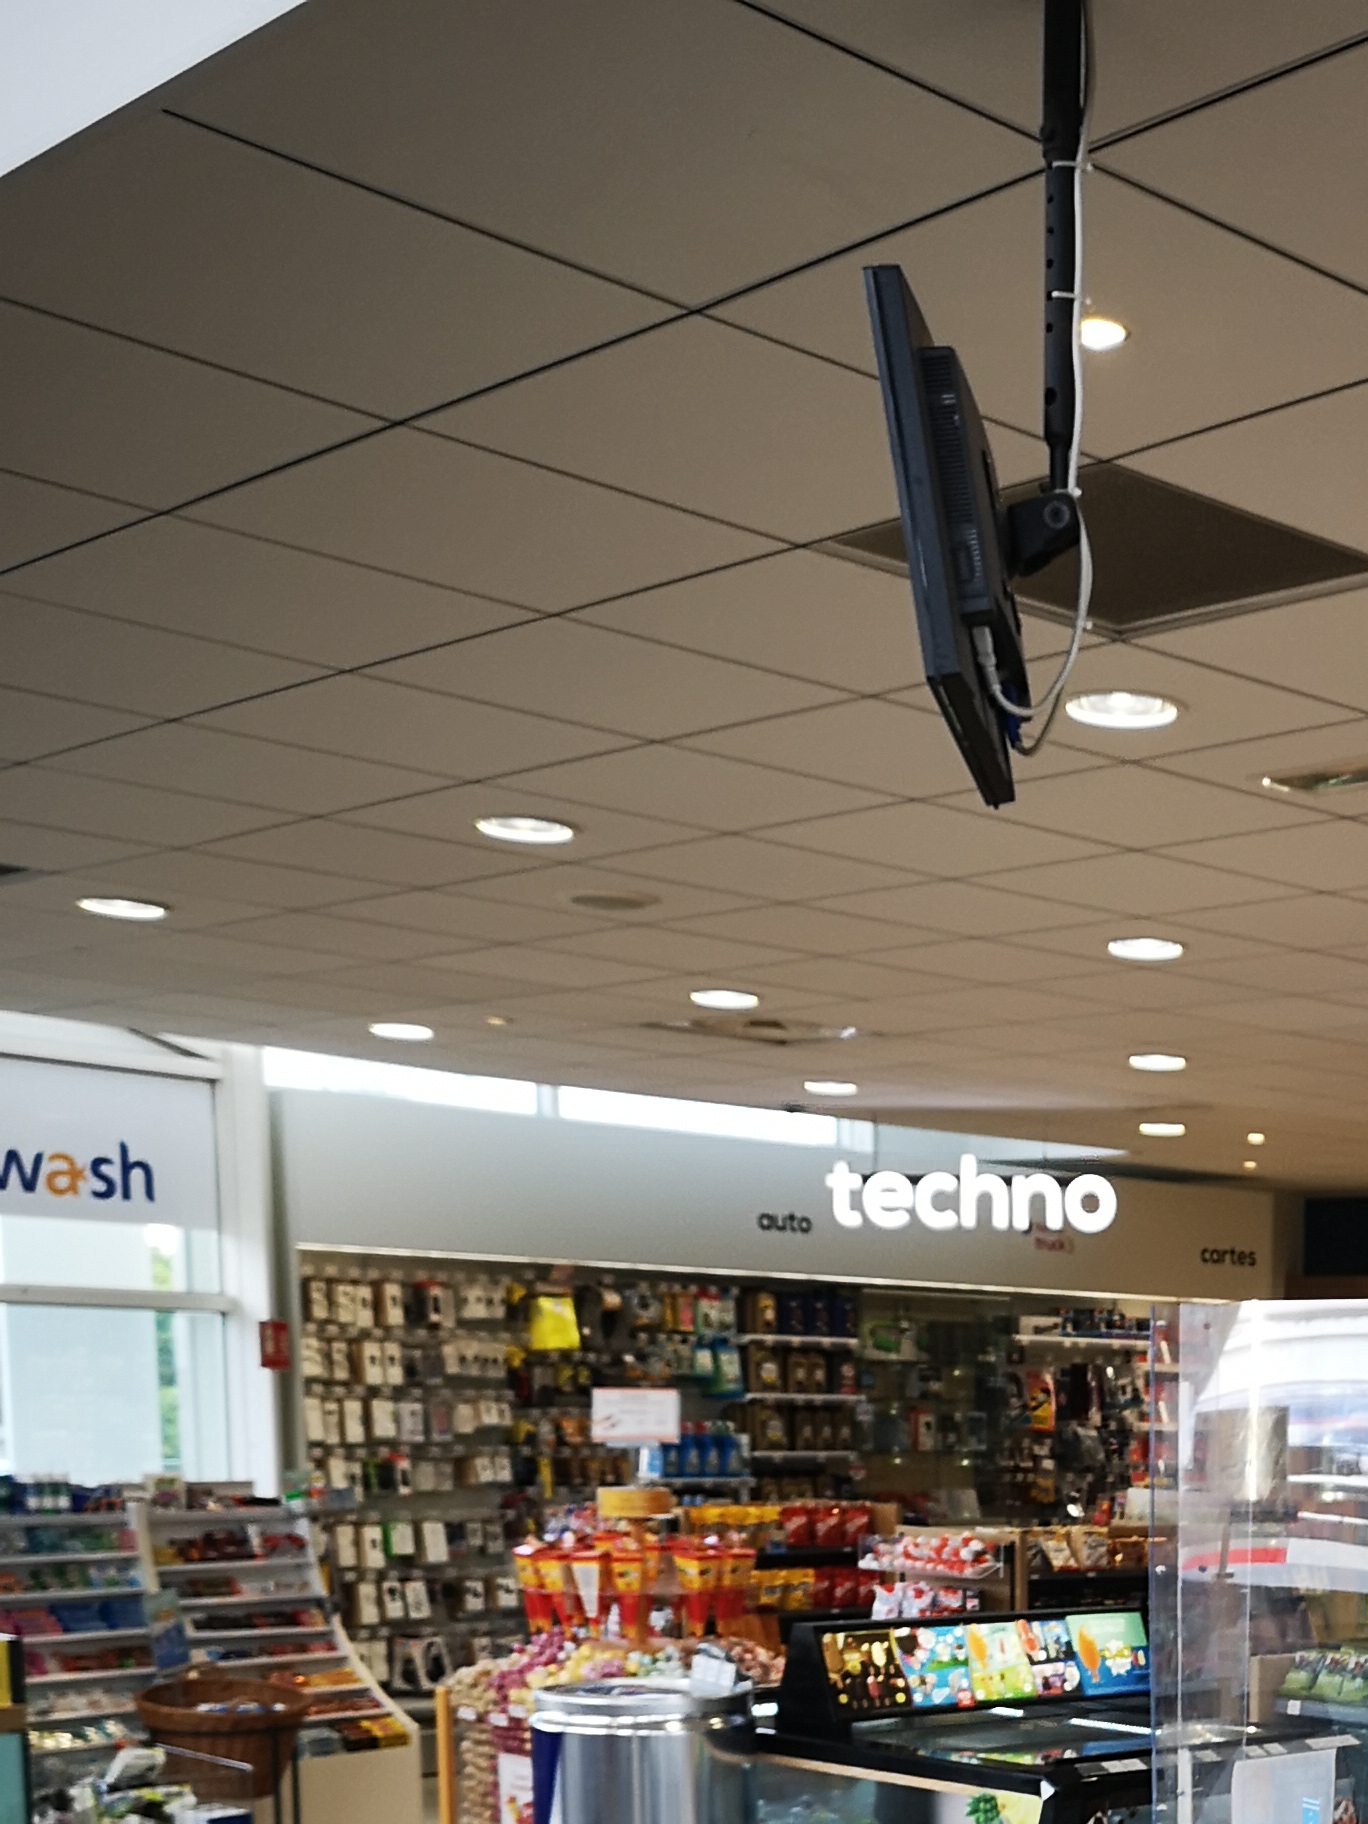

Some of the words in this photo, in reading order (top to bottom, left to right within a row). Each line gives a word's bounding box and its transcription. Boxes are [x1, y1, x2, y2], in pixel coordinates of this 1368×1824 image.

[824, 1153, 1118, 1234] techno
[757, 1211, 812, 1234] auto
[1201, 1244, 1258, 1267] cartes
